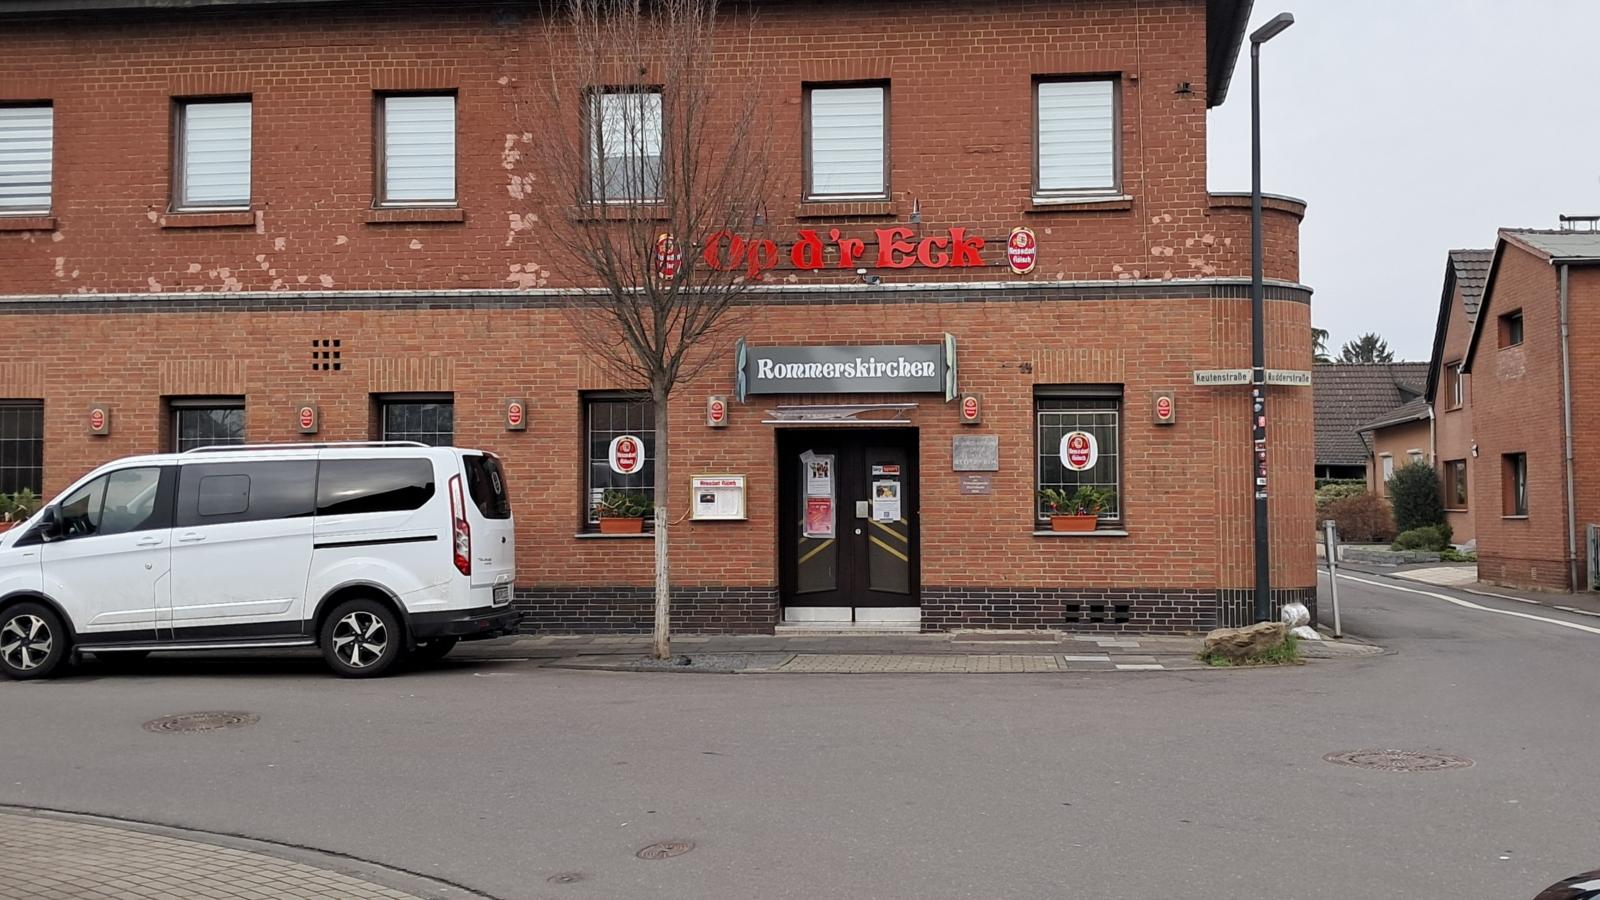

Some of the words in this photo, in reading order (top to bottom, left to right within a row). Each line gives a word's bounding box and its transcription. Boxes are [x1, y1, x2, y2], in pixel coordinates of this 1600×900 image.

[703, 229, 779, 281] Op
[875, 227, 985, 268] Eck
[757, 357, 936, 379] Rommerskirchen
[1196, 373, 1247, 382] Keutenstraße
